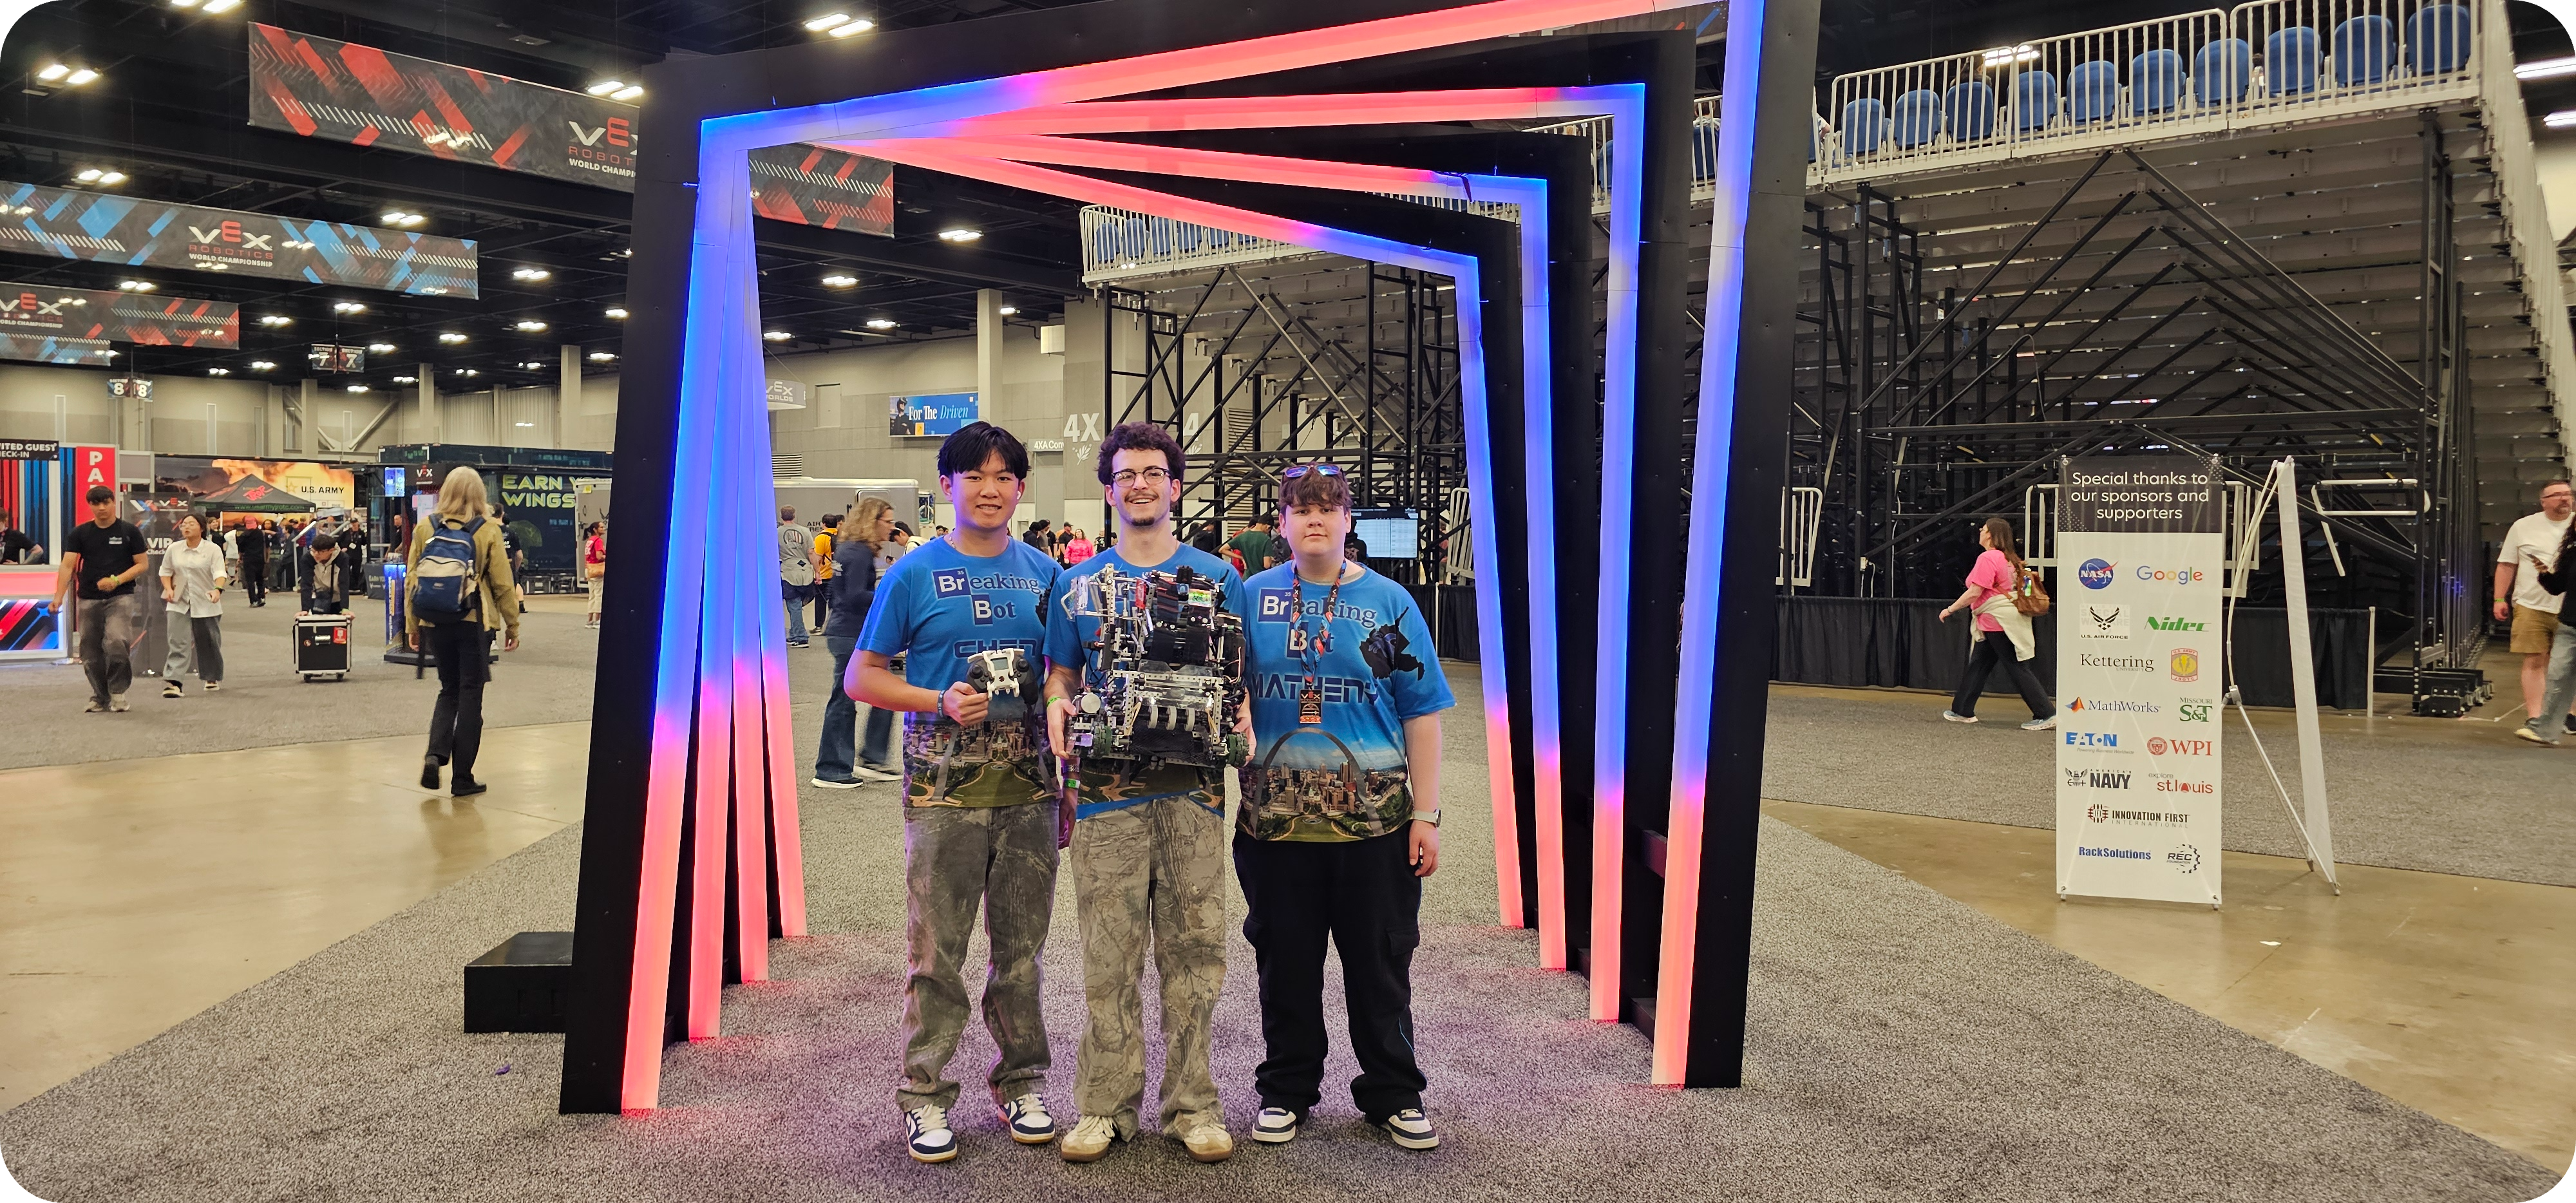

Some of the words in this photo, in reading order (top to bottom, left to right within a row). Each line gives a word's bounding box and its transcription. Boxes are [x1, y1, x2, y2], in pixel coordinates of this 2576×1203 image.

[568, 117, 638, 156] VE
[569, 158, 600, 171] WORLD
[188, 220, 273, 251] VEX
[189, 244, 274, 260] ROBOTICS
[189, 253, 216, 261] WORLD
[218, 256, 273, 267] CHAMPIONSHIP
[17, 320, 63, 328] CHAMPIONSHIP
[346, 354, 357, 368] 7
[113, 383, 124, 395] 8
[138, 384, 147, 397] 8
[766, 394, 793, 403] ORLDS
[909, 406, 923, 421] For
[923, 405, 938, 420] The
[940, 404, 969, 419] Driven
[1063, 412, 1101, 442] 4X
[0, 442, 24, 451] ITED
[24, 443, 56, 451] GUEST
[1034, 440, 1048, 450] 4XA
[502, 475, 563, 491] EARN
[2072, 471, 2128, 488] Special
[2133, 471, 2186, 485] thanks
[2191, 473, 2208, 485] to
[502, 491, 576, 507] WINGS
[2071, 491, 2097, 502] our
[2101, 491, 2173, 504] sponsors
[2177, 488, 2209, 502] and
[2096, 507, 2183, 522] supporters
[147, 537, 173, 549] VIP
[2080, 569, 2112, 580] NASA
[2136, 565, 2203, 585] Google
[938, 573, 1041, 594] Breaking
[974, 600, 1017, 618] Bot
[2144, 616, 2211, 632] Nidec
[2080, 654, 2154, 672] Kettering
[2088, 700, 2159, 713] MathWorks
[2179, 704, 2213, 722] S&T
[2066, 732, 2117, 747] EATON
[2170, 739, 2213, 756] WPI
[2090, 773, 2131, 790] NAVY
[2112, 810, 2161, 822] INNOVATION
[2164, 813, 2189, 823] FIRST
[2112, 820, 2188, 828] INTERNATIONAL
[2079, 846, 2152, 860] RackSolutions
[2167, 853, 2192, 861] REC
